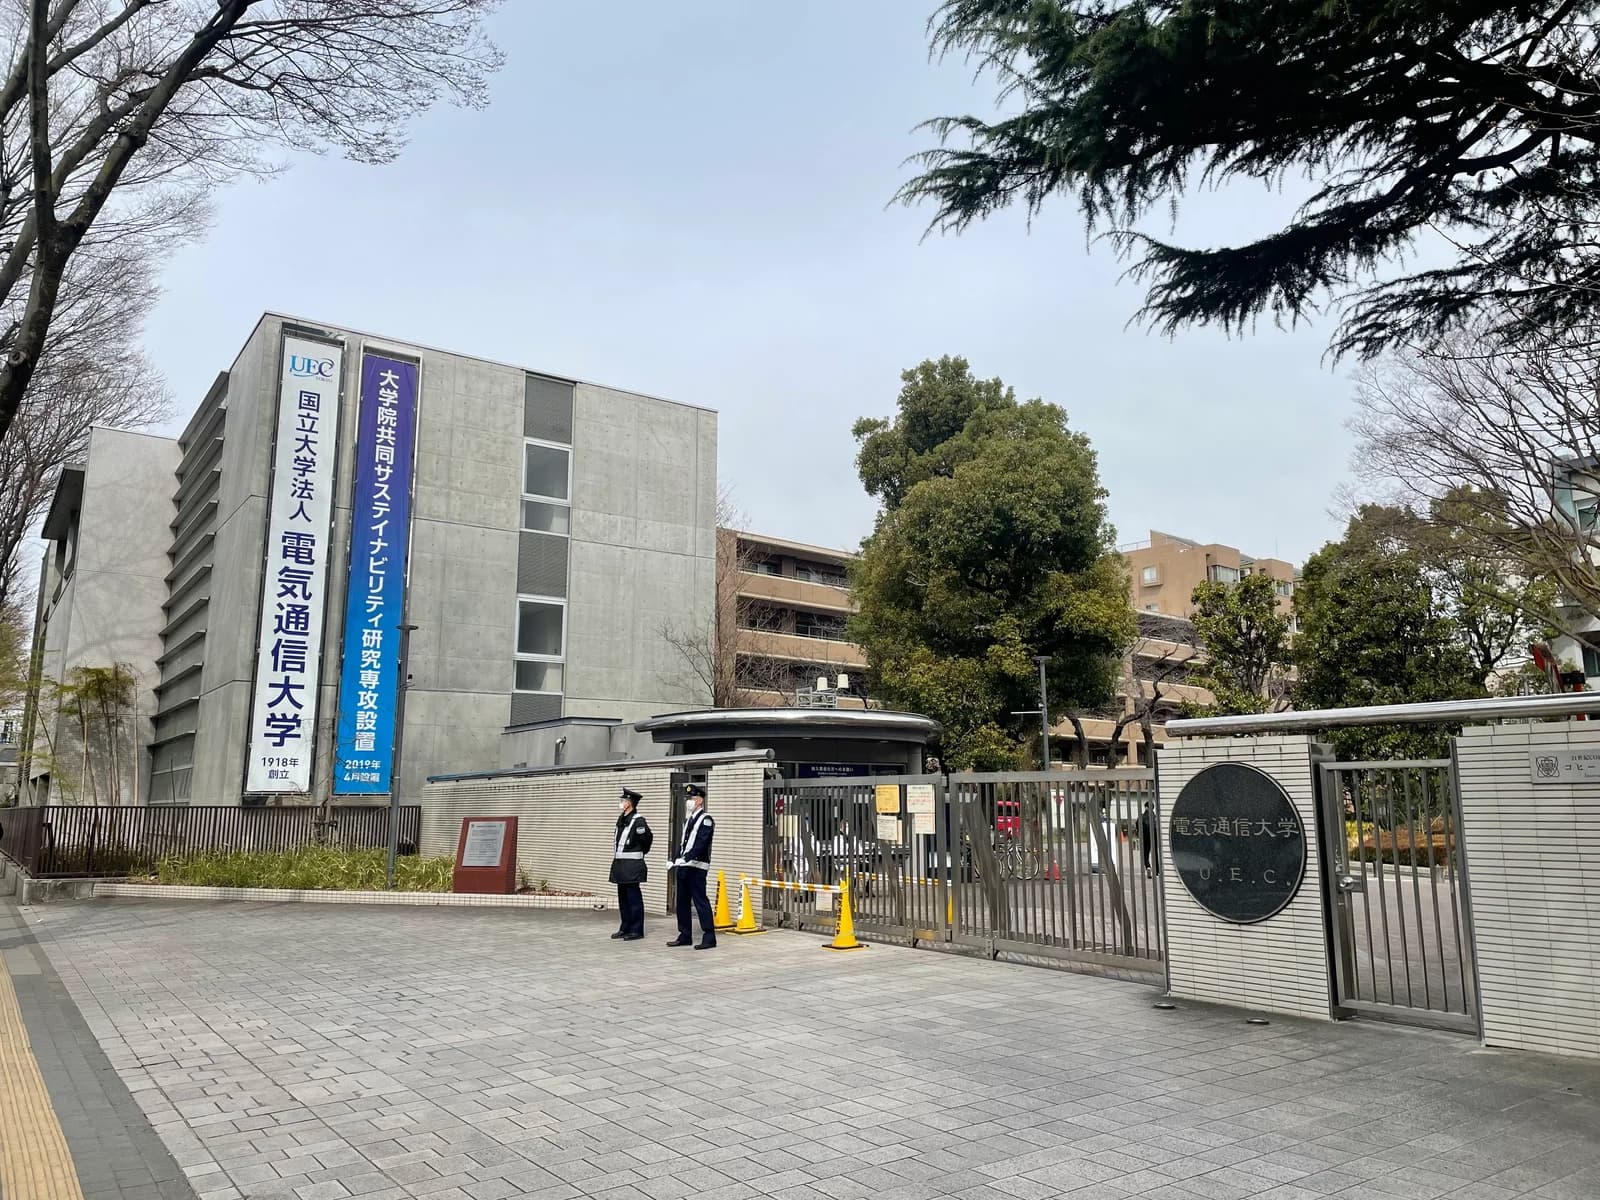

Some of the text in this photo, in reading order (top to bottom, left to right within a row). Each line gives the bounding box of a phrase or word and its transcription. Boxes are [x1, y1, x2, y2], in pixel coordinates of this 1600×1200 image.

[289, 354, 335, 378] UEC
[263, 390, 321, 747] 国立大学法人 電気通信大学
[354, 369, 400, 752] 大学院共同サステイナビリティ研究専攻設置
[261, 757, 299, 767] 1918年
[345, 759, 381, 770] 2019年
[268, 769, 290, 780] 創立
[1173, 816, 1300, 838] 電気通信大学
